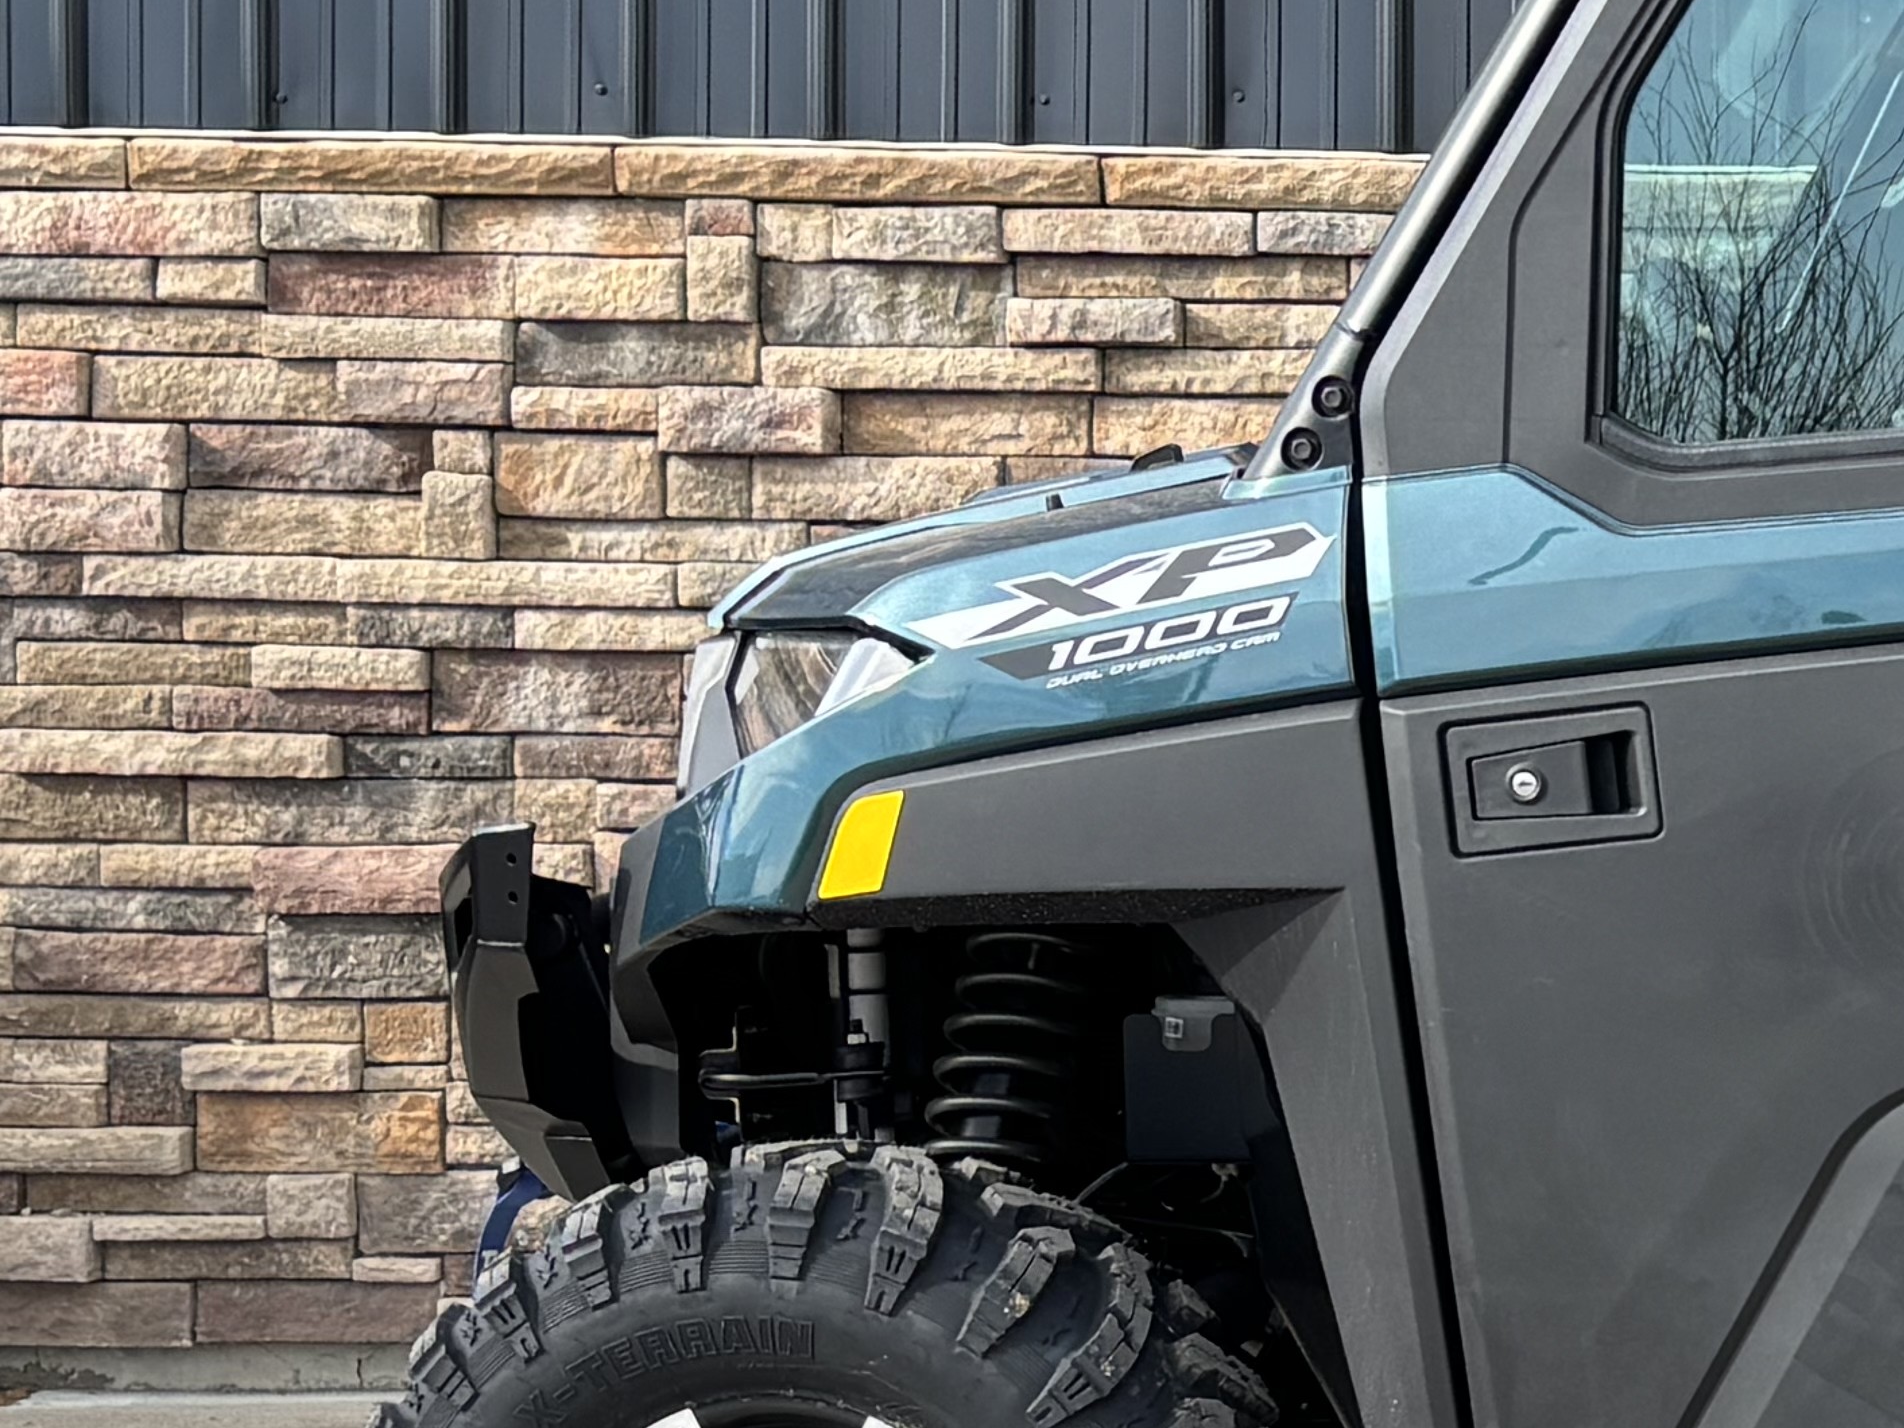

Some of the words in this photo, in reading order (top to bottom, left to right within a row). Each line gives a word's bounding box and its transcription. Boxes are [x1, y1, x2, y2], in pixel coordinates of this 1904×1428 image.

[968, 526, 1318, 642] XP
[1045, 667, 1104, 690] DUAL
[1108, 642, 1228, 676] OVERHEAD
[1230, 630, 1282, 651] CAM
[1048, 595, 1292, 672] 1000
